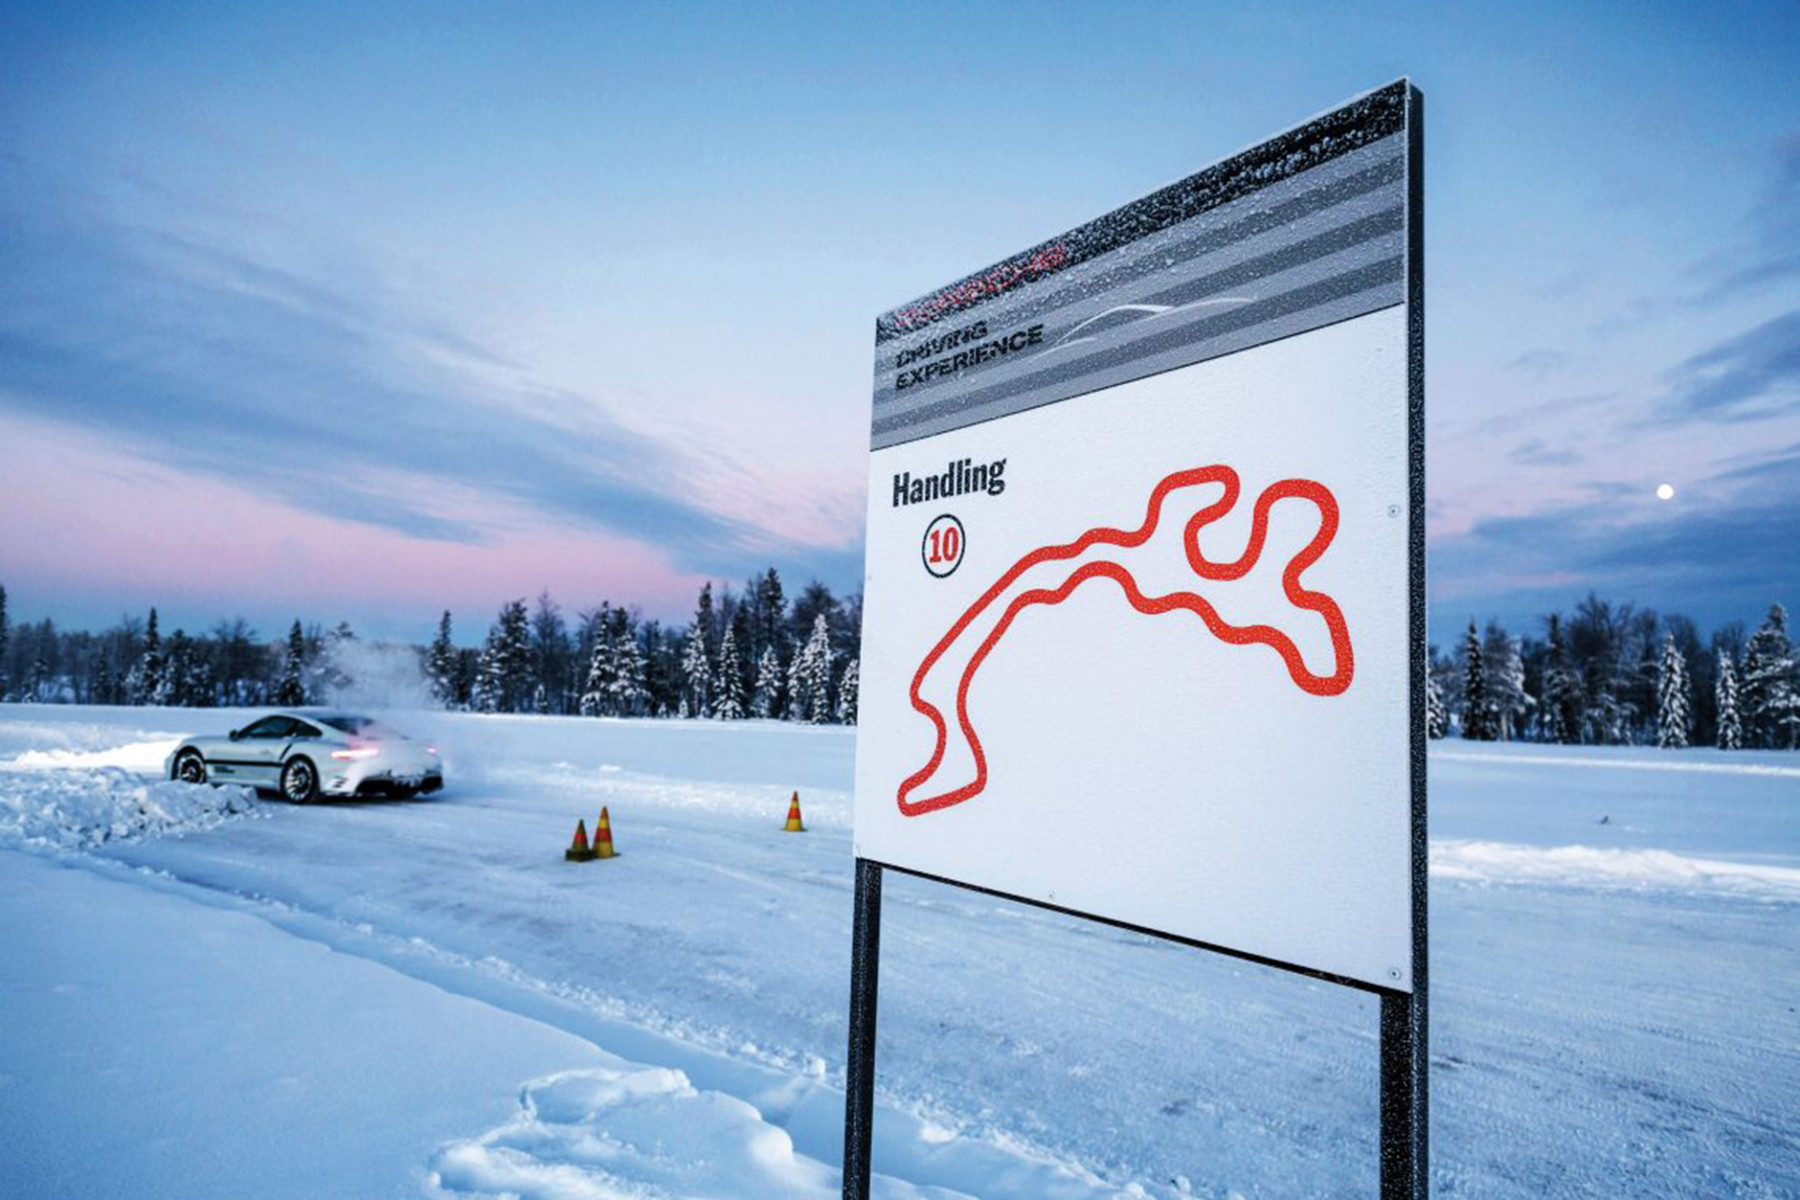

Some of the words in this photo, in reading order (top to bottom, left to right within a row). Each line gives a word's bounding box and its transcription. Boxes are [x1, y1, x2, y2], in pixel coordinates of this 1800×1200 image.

[895, 323, 1044, 391] EXPERIENCE
[892, 457, 1007, 508] Handling
[929, 526, 960, 564] 10
